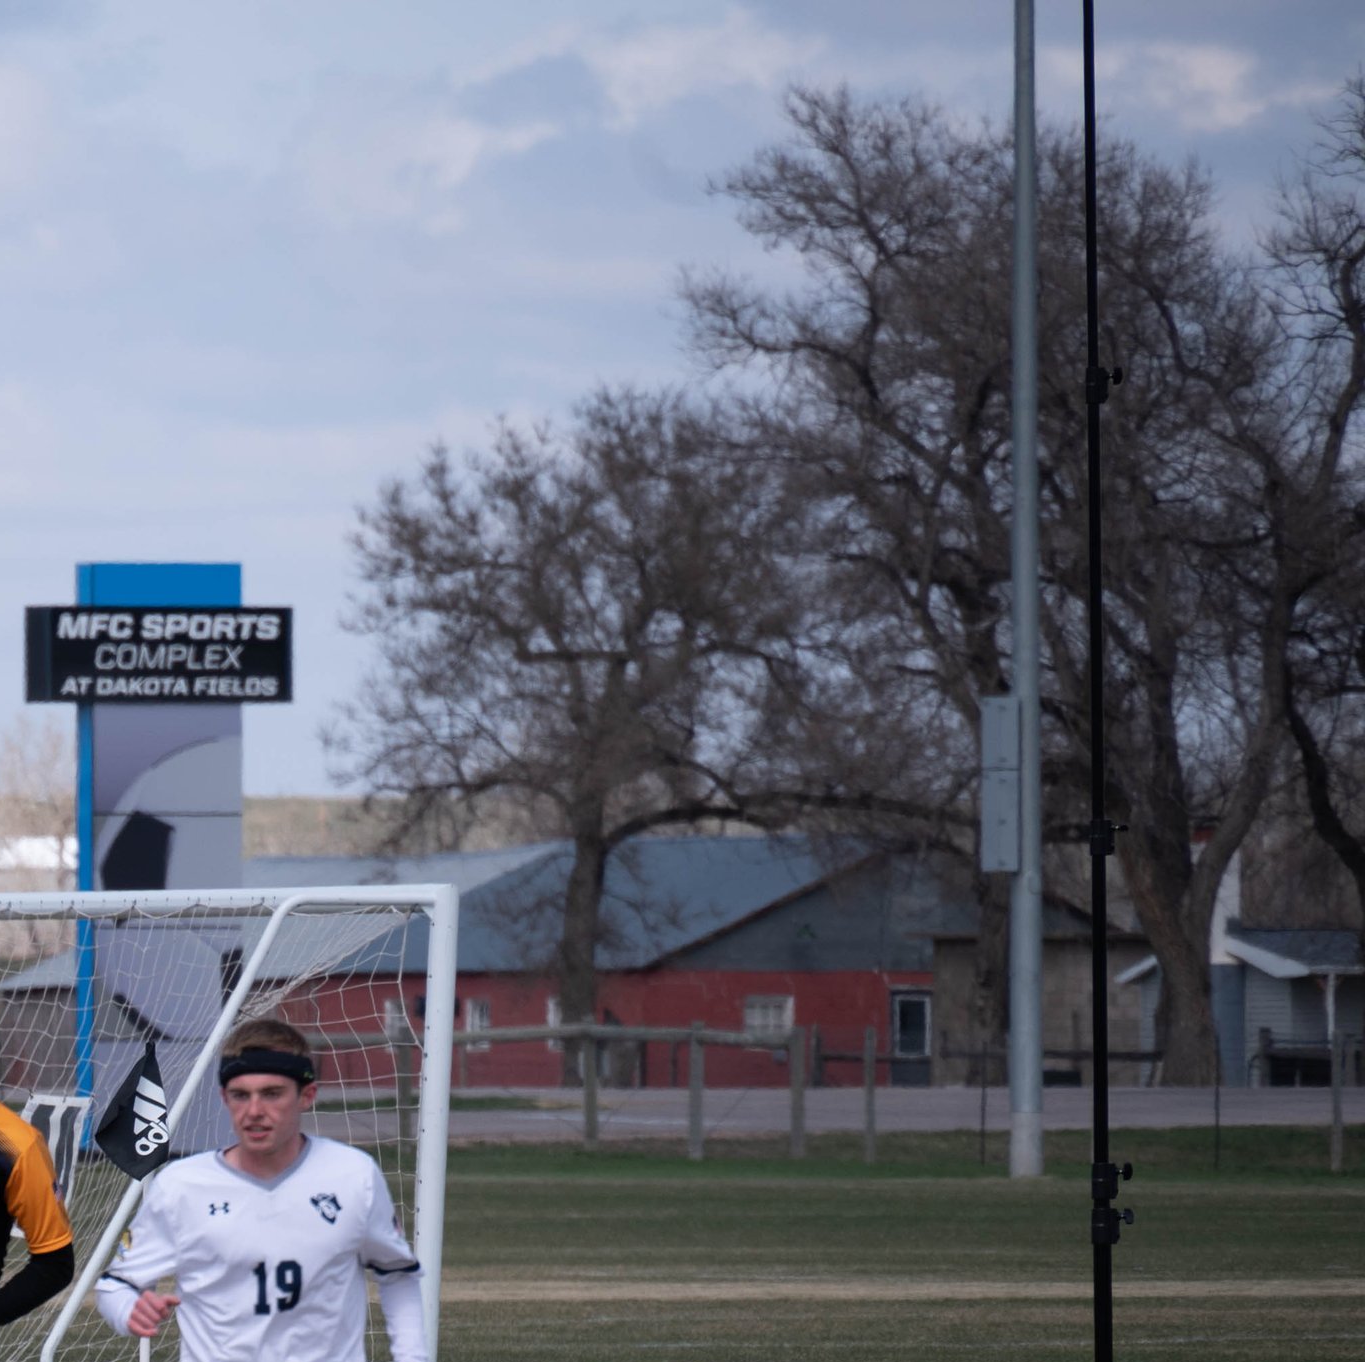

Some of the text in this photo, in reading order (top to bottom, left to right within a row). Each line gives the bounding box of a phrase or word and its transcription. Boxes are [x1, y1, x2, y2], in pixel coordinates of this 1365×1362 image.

[57, 612, 281, 641] MFC SPORTS
[93, 643, 245, 671] COMPLEX
[60, 676, 279, 697] AT DAKOTA FIELDS
[253, 1259, 303, 1316] 19
